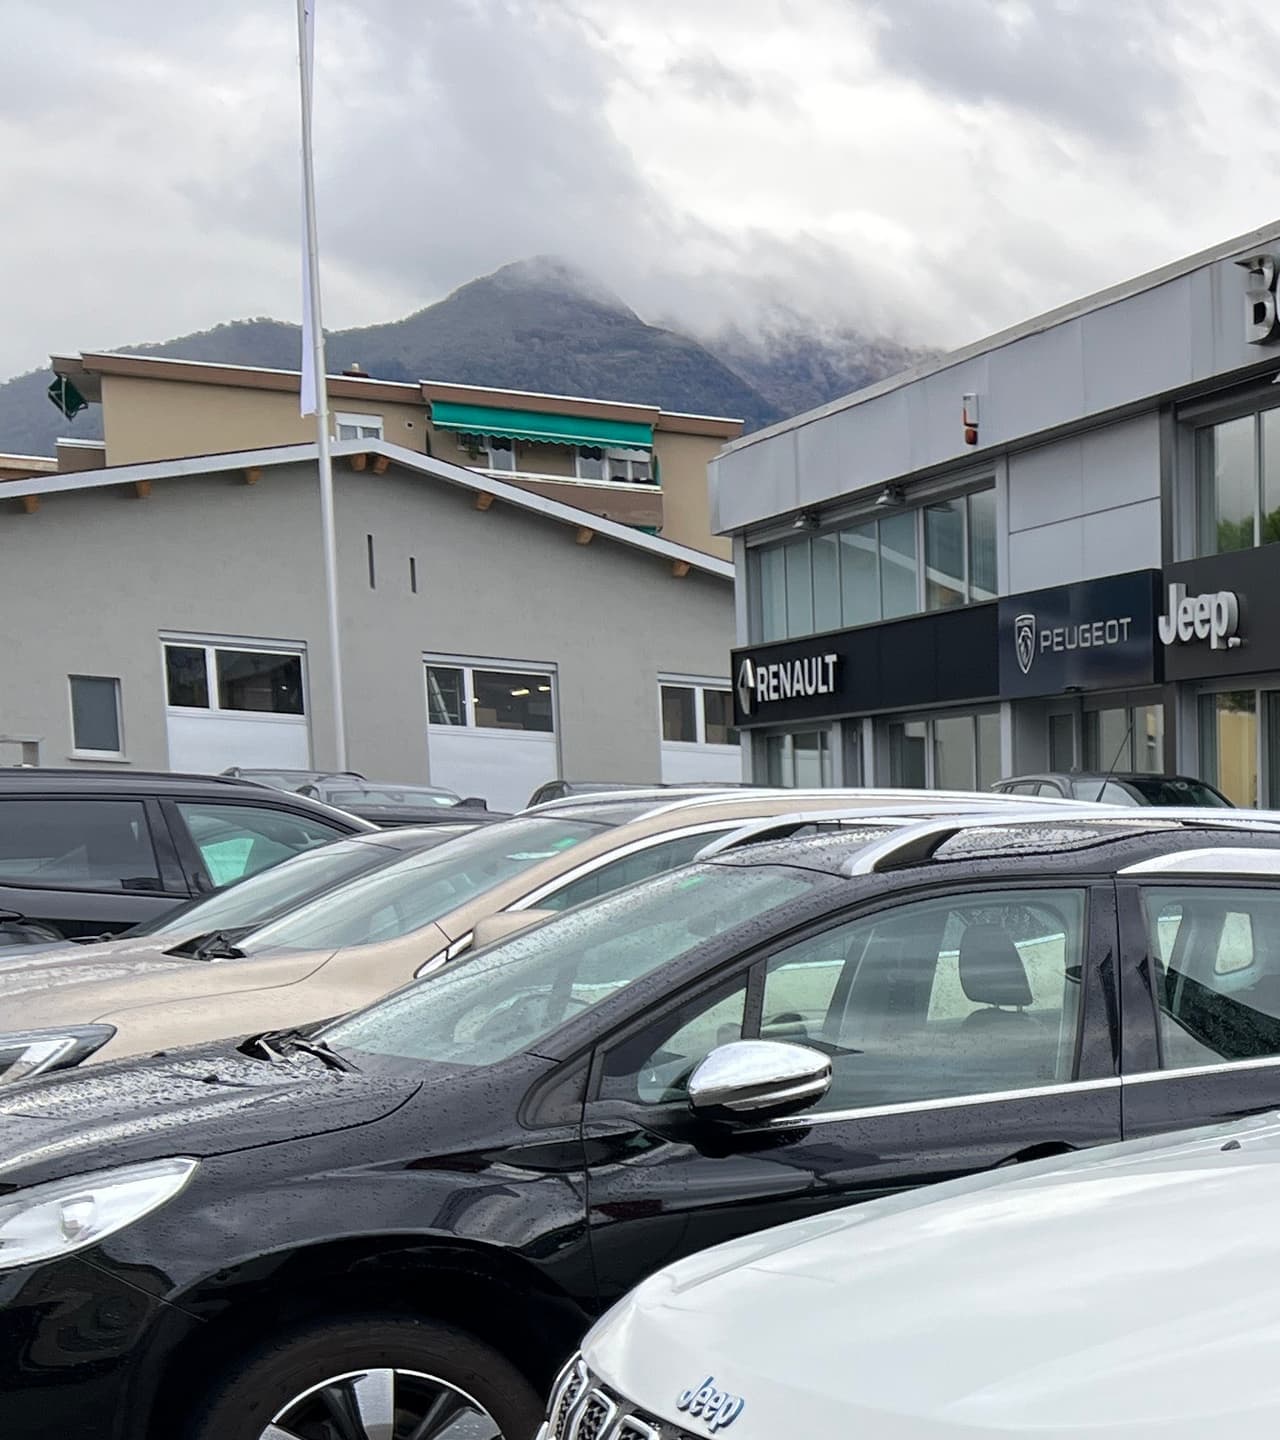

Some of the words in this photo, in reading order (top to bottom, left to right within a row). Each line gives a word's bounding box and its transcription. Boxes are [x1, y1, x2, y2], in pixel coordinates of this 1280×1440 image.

[1040, 617, 1132, 653] PEUGEOT
[1158, 582, 1239, 650] Jeep
[756, 653, 838, 702] RENAULT
[676, 1375, 745, 1434] Jeep
